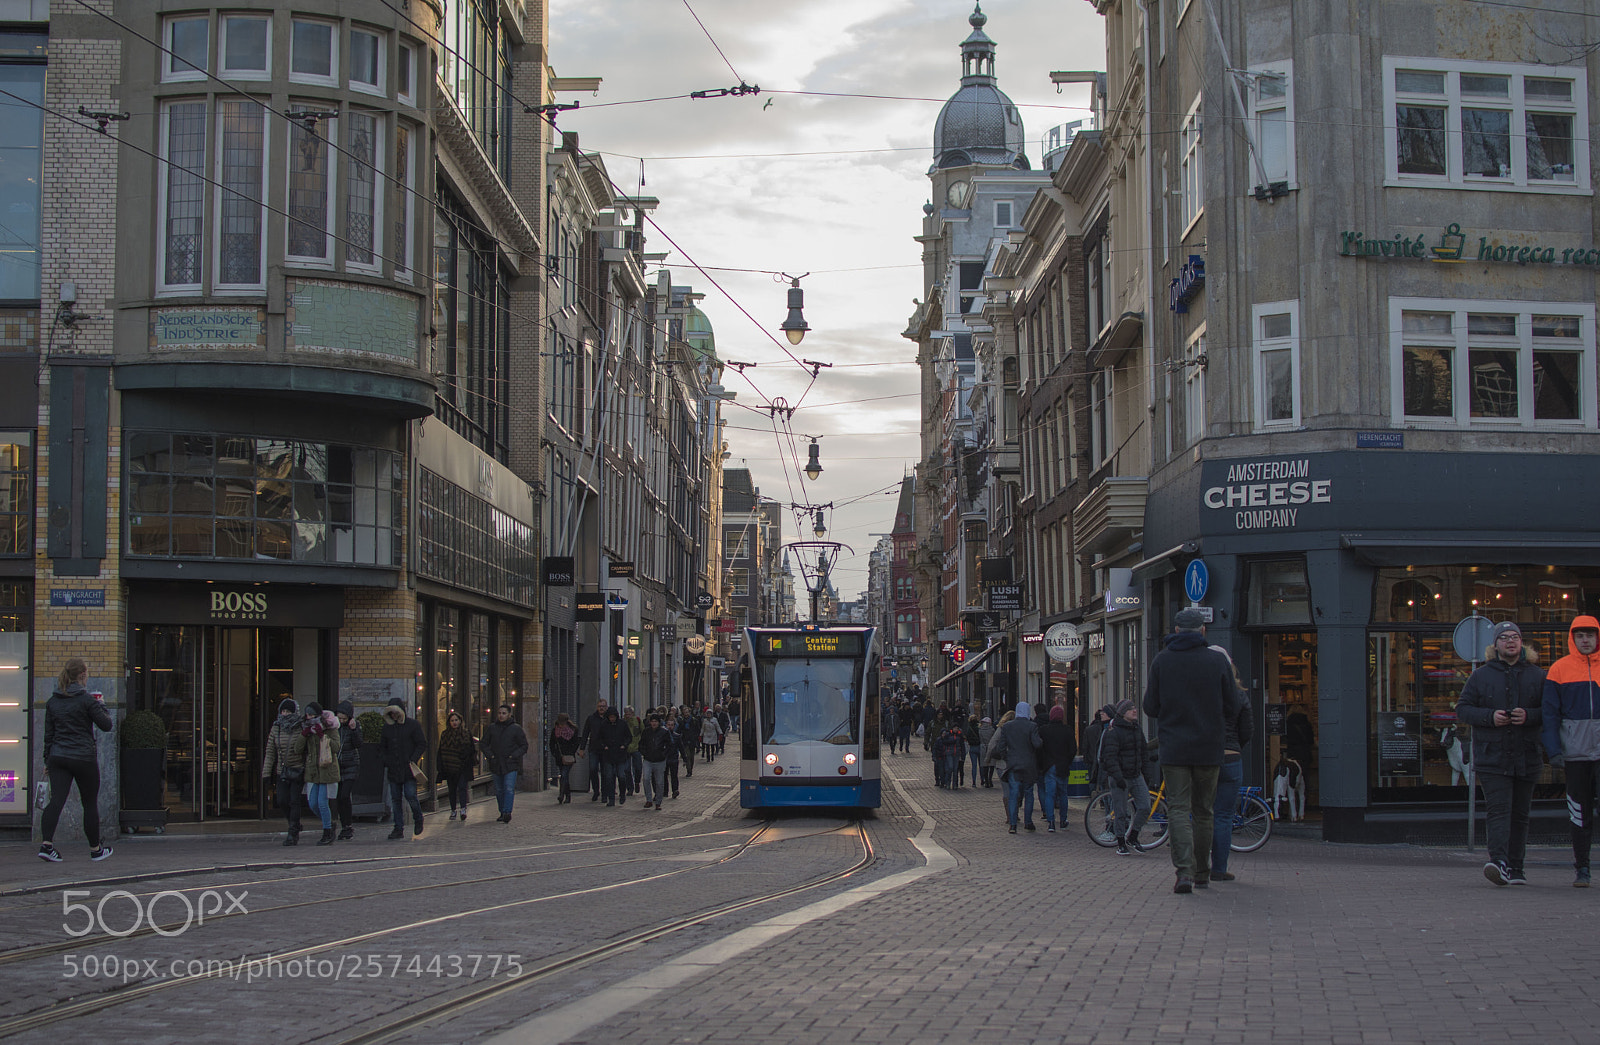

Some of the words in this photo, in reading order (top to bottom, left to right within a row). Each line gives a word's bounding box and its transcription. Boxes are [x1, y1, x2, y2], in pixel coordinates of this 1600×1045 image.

[1340, 231, 1425, 258] l'invité
[1478, 237, 1555, 264] horeca
[1227, 460, 1309, 482] AMSTERDAM
[1204, 480, 1331, 509] CHEESE
[1235, 508, 1298, 529] COMPANY
[991, 586, 1019, 595] LUSH
[210, 591, 267, 612] BOSS
[768, 636, 773, 652] 1
[805, 636, 839, 644] Centraal
[1046, 637, 1083, 647] BAKERY
